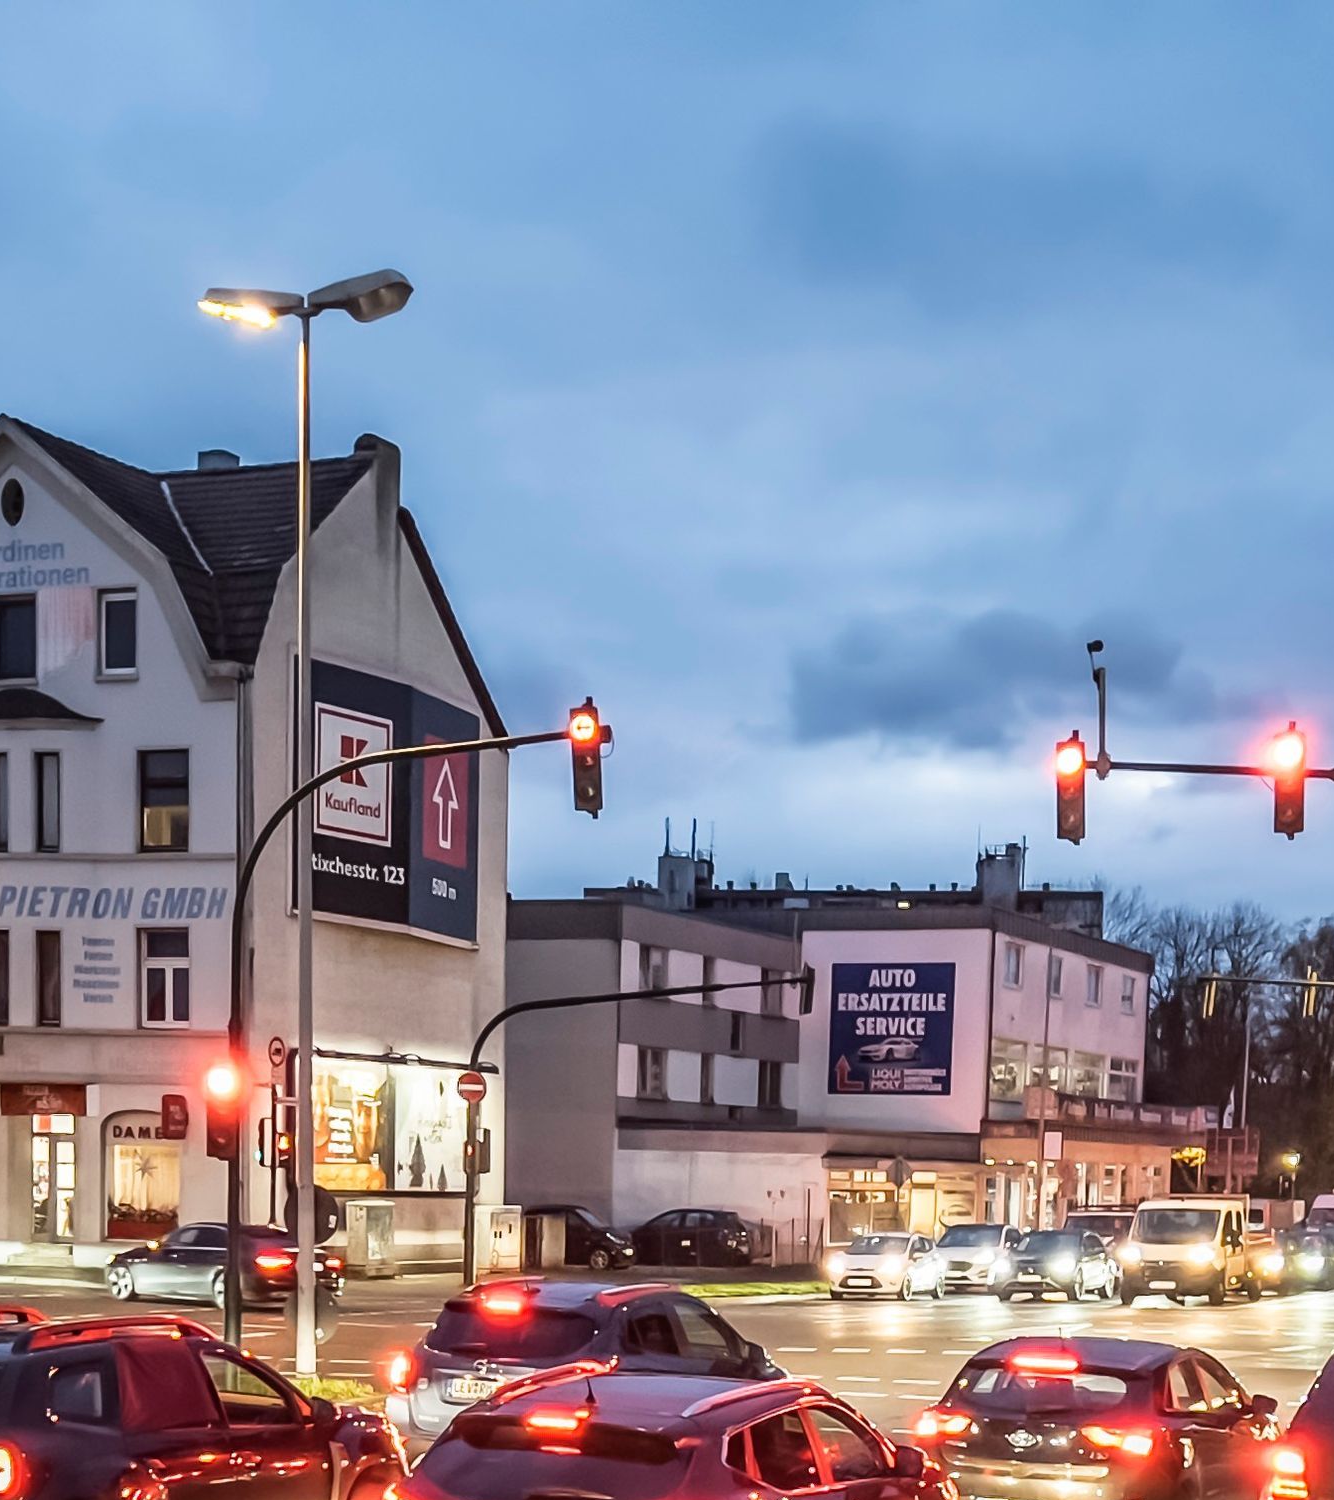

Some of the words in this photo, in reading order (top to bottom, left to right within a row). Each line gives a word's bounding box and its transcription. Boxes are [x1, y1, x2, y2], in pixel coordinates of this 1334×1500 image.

[325, 792, 381, 819] Kaufland
[311, 853, 380, 881] tixchesstr.
[383, 866, 406, 886] 123
[141, 887, 228, 919] GMBH
[869, 969, 916, 988] AUTO
[837, 993, 947, 1012] ERSATZTEILE
[855, 1017, 926, 1036] SERVICE
[872, 1068, 901, 1079] LIQUI
[871, 1080, 901, 1091] MOLY
[113, 1125, 165, 1140] DAME
